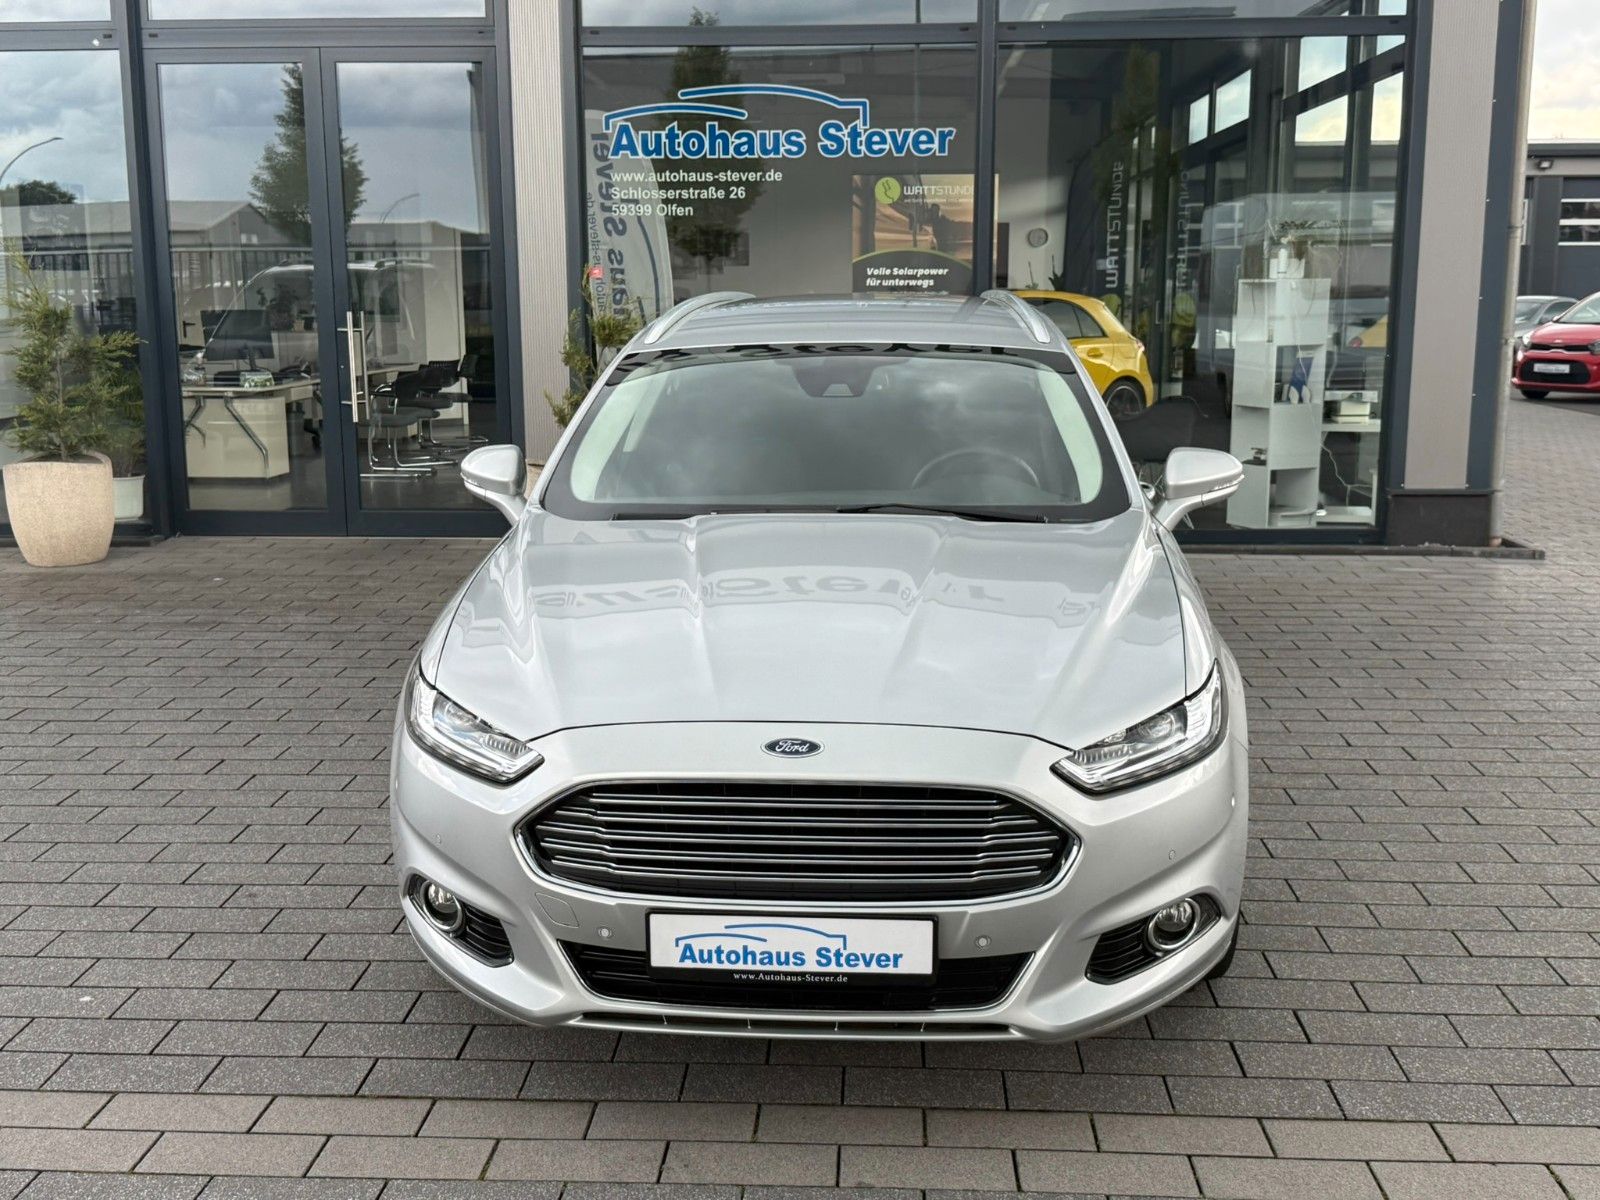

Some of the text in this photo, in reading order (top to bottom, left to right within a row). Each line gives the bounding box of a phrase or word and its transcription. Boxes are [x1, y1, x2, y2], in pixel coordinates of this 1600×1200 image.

[608, 119, 956, 159] Autohaus Stever
[610, 169, 783, 184] www.autohaus-stever.de
[610, 186, 746, 200] Schlosserstraße 26
[903, 184, 975, 196] WATTSTUND
[611, 202, 694, 217] 59399 Olfen
[1105, 160, 1124, 289] WATTSTUNDE
[866, 267, 949, 278] Volle Solarpower
[865, 278, 934, 289] für unterwegs
[775, 740, 810, 752] Ford
[678, 943, 904, 969] Autohaus Stever
[733, 972, 848, 984] www.Autohaus-Stever.de
